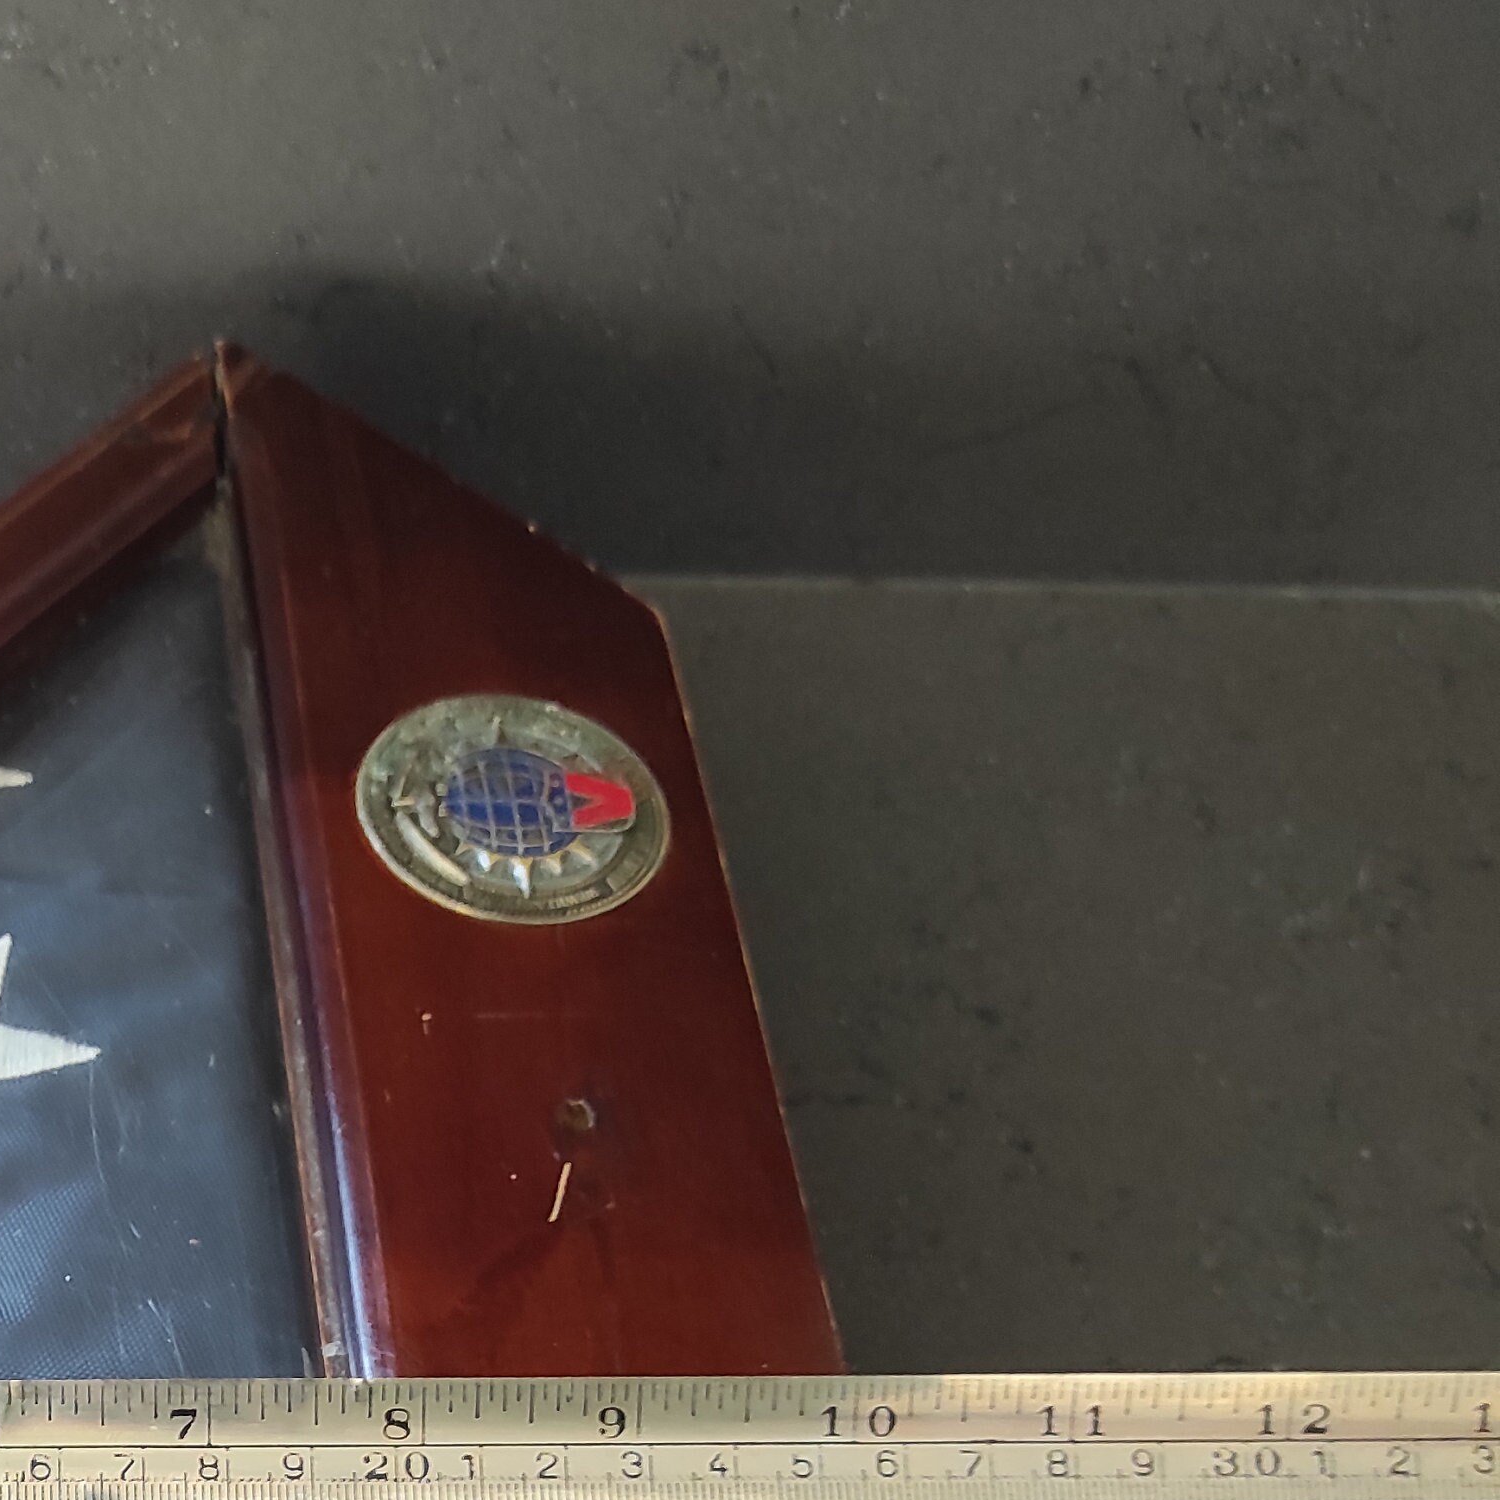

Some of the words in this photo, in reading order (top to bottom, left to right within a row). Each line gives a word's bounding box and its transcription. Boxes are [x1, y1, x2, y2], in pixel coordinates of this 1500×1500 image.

[169, 1409, 197, 1441] 7
[382, 1408, 411, 1440] 8
[598, 1406, 626, 1439] 9
[822, 1405, 897, 1438] 10
[1039, 1404, 1105, 1437] 11
[1257, 1403, 1331, 1435] 12
[29, 1454, 52, 1481] 6
[113, 1454, 136, 1481] 7
[198, 1454, 221, 1481] 8
[282, 1452, 305, 1480] 9
[460, 1453, 477, 1481] 1
[535, 1452, 560, 1479] 2
[620, 1451, 643, 1479] 3
[708, 1451, 729, 1477] 4
[792, 1451, 814, 1478] 5
[876, 1449, 898, 1478] 6
[960, 1449, 982, 1476] 7
[1047, 1450, 1069, 1476] 8
[1132, 1449, 1155, 1476] 9
[1311, 1449, 1329, 1476] 1
[1385, 1447, 1412, 1476] 2
